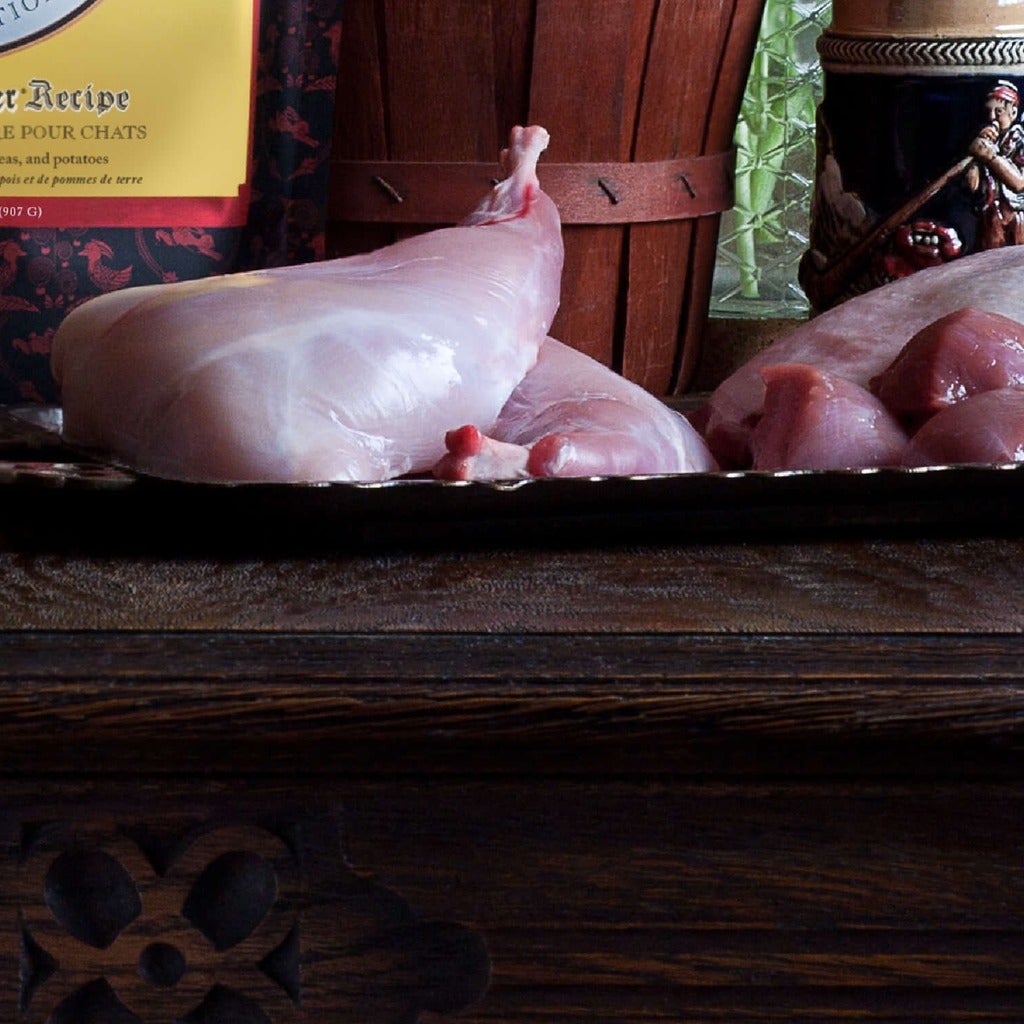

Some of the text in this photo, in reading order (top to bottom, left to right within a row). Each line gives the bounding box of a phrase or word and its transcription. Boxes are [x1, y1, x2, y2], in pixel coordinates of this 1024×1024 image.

[24, 78, 130, 117] Recipe
[20, 124, 76, 140] POUR
[80, 124, 147, 140] CHATS
[25, 151, 50, 165] and
[53, 152, 109, 169] potatoes
[23, 175, 34, 185] et
[36, 173, 50, 185] de
[51, 176, 97, 188] pommes
[99, 173, 113, 185] de
[116, 175, 144, 185] terre
[27, 206, 43, 219] G)
